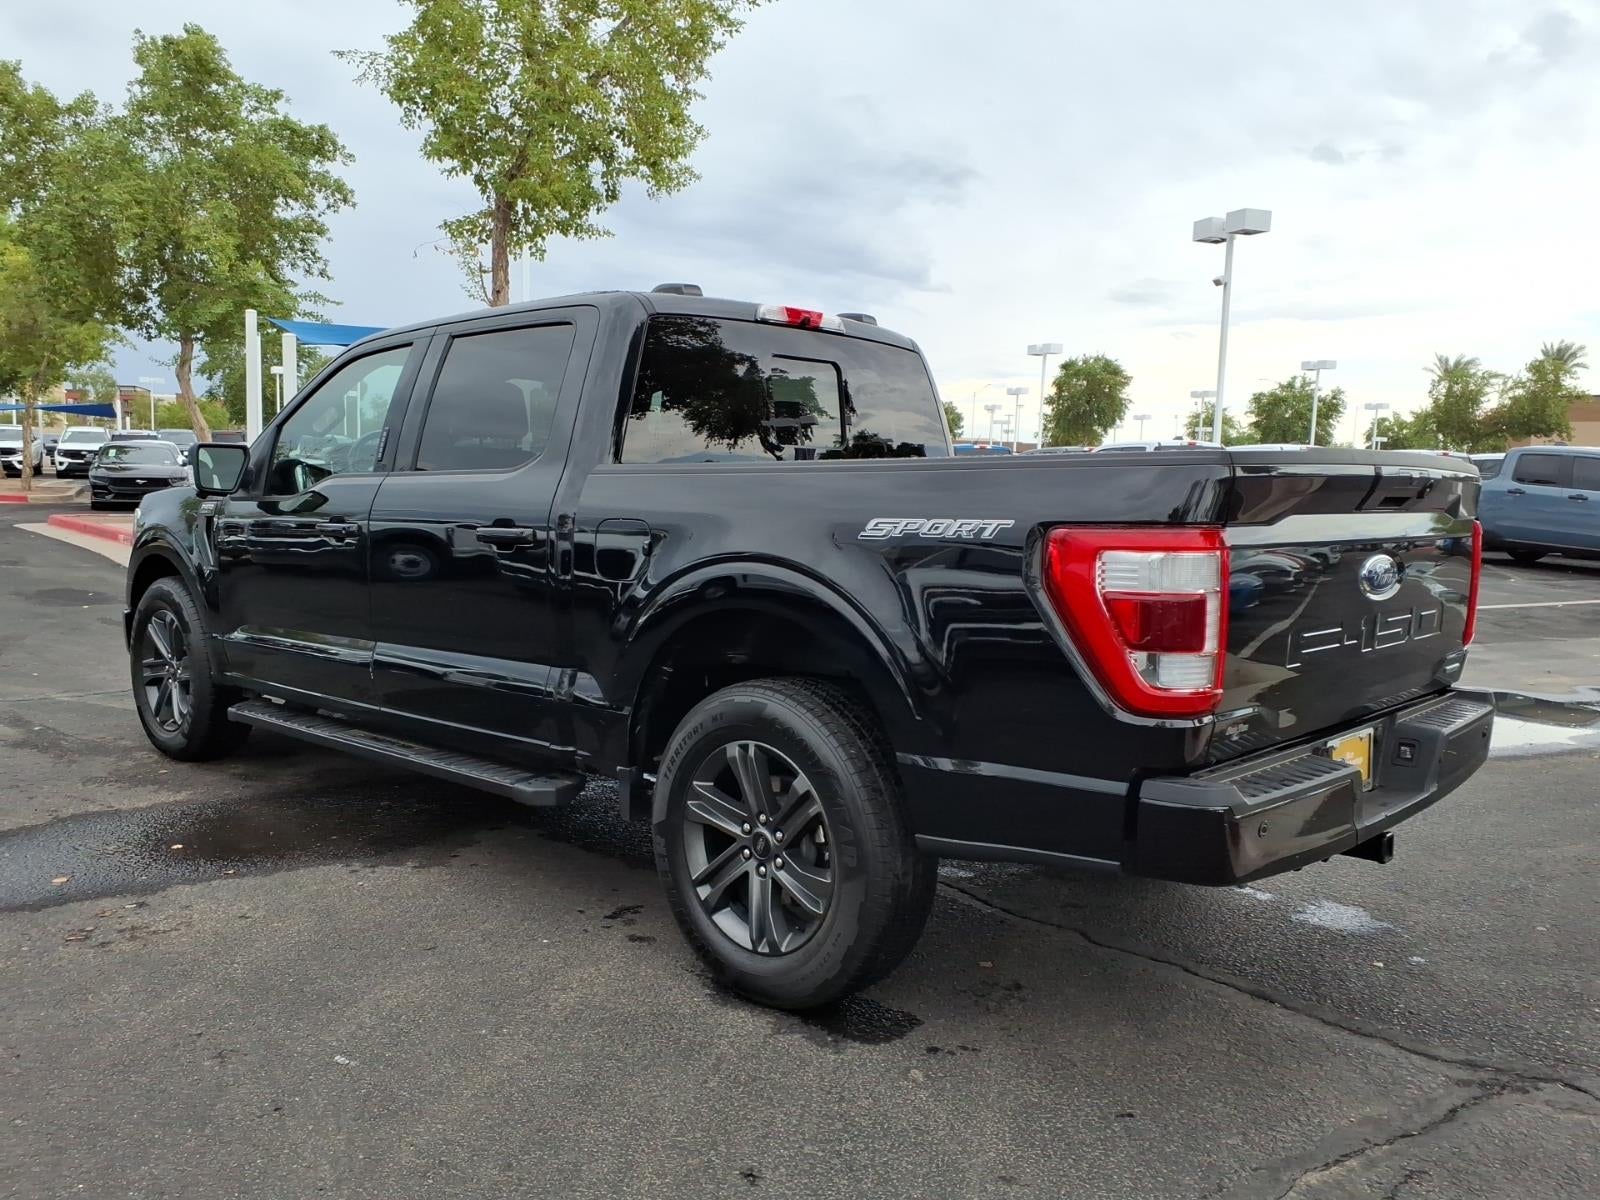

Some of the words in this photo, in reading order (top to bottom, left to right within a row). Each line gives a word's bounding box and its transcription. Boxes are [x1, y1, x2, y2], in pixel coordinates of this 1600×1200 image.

[858, 518, 1015, 540] SPORT
[1286, 603, 1443, 668] F-150
[664, 722, 704, 781] TERRITORY
